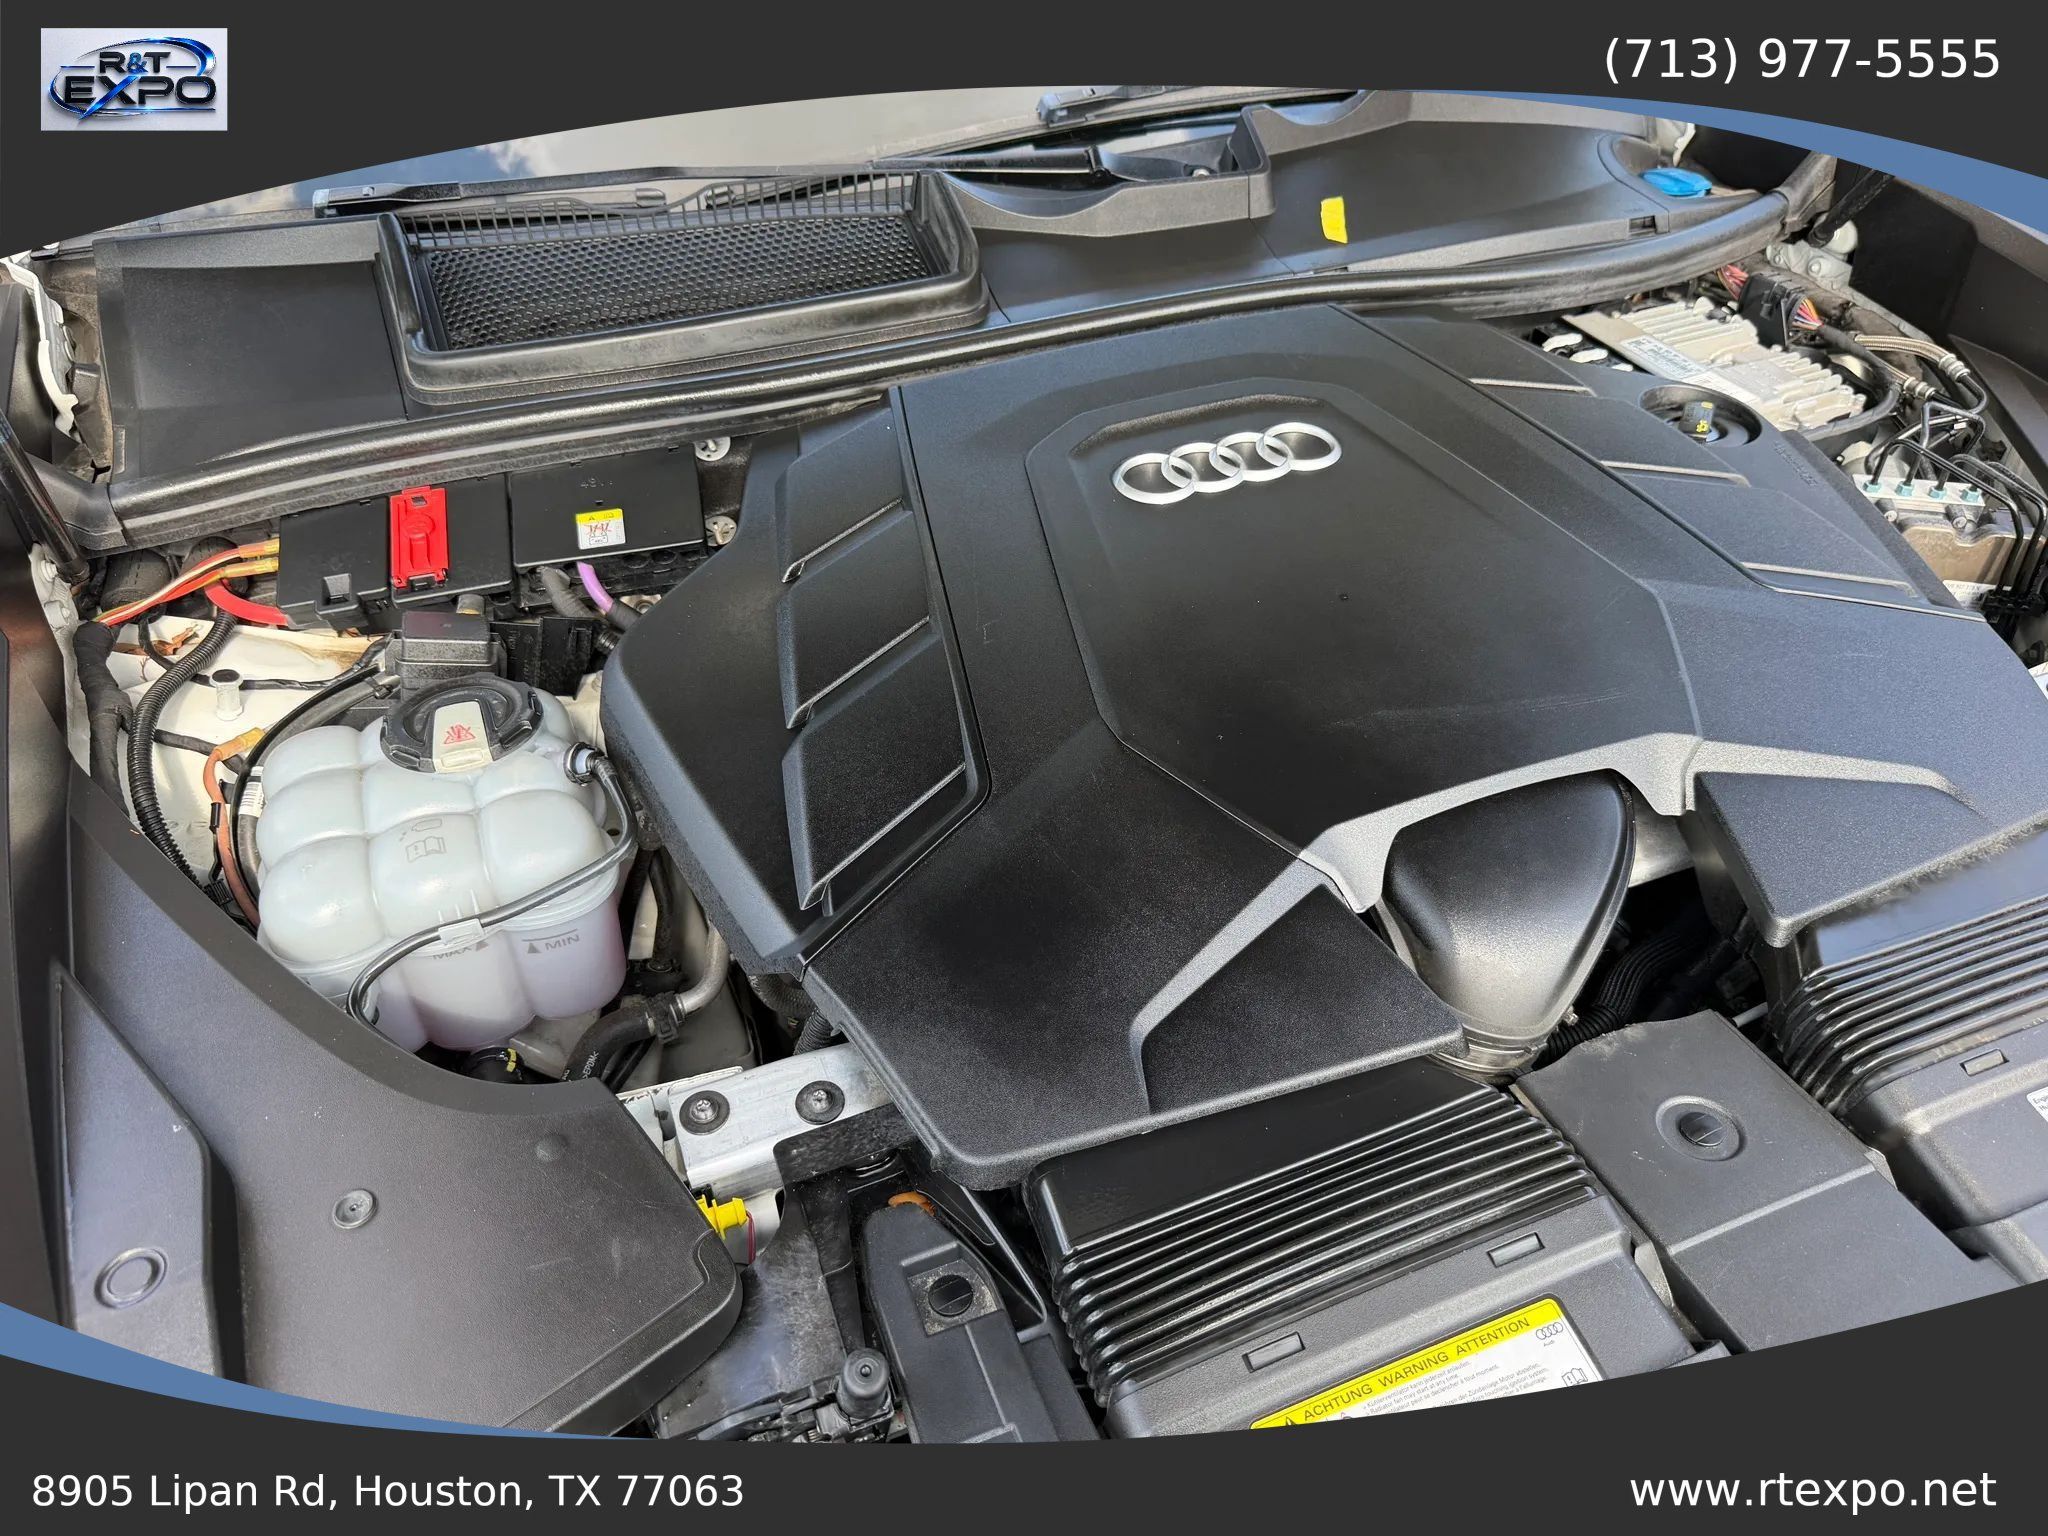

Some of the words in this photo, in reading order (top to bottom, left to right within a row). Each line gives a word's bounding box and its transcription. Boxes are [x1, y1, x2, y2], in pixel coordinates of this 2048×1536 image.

[545, 934, 580, 951] MIN
[1304, 1383, 1373, 1421] ACHTUNG
[1378, 1351, 1449, 1387] WARNING
[1456, 1317, 1530, 1356] ATTENTION
